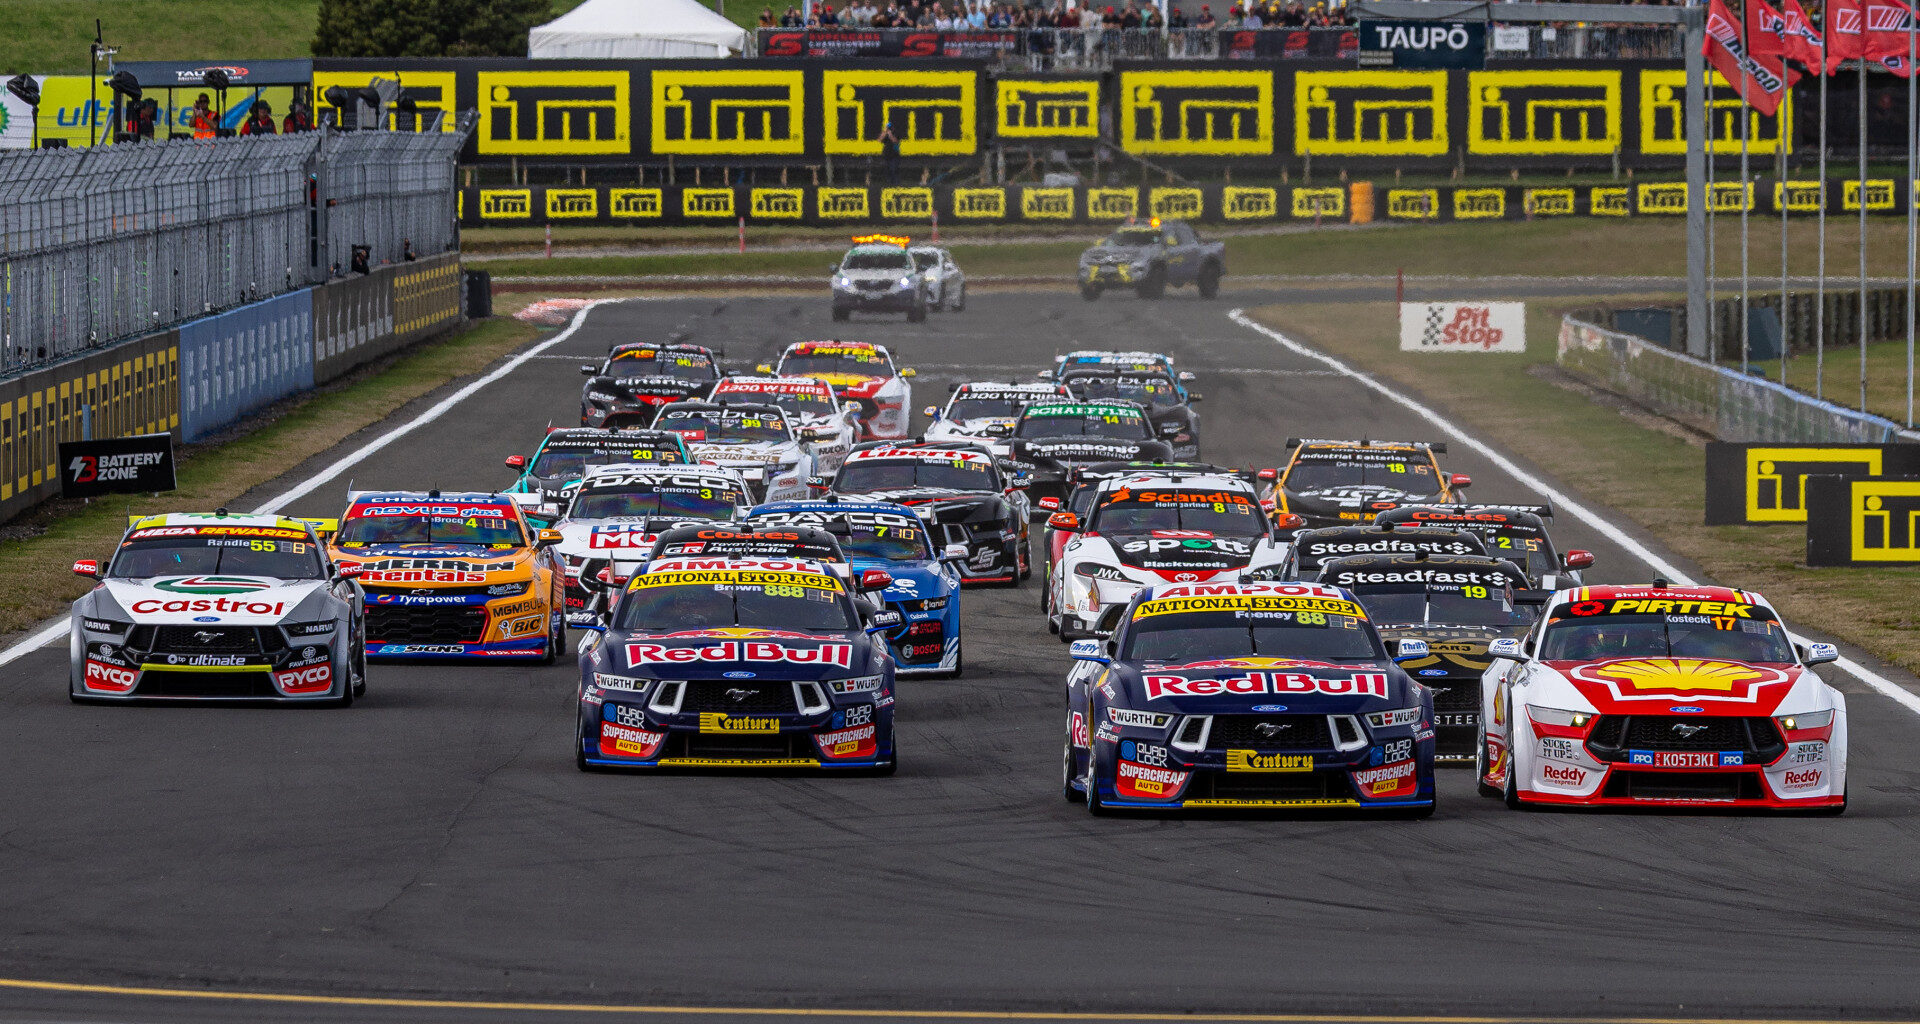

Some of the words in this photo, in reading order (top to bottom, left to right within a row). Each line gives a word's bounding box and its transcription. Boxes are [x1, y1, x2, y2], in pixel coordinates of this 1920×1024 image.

[1375, 24, 1469, 49] TAUPŌ
[1455, 307, 1489, 329] Pit
[1442, 324, 1503, 350] Stop
[1028, 406, 1141, 419] SCHAEFFLER
[743, 418, 761, 429] 99
[1103, 416, 1120, 425] 14
[633, 448, 653, 459] 20
[858, 448, 979, 462] Liberty
[1025, 442, 1141, 454] Panasonic
[98, 451, 163, 469] BATTERY
[1300, 452, 1352, 462] Industrial
[97, 466, 138, 481] ZONE
[1387, 462, 1406, 475] 18
[593, 473, 730, 490] DAYCO
[653, 486, 699, 496] Cameron
[701, 487, 713, 499] 3
[1139, 490, 1249, 506] Scandia
[371, 496, 497, 504] CHEVROLET
[460, 507, 504, 518] glass
[800, 503, 865, 513] Etheridge
[870, 505, 902, 514] Ford
[1213, 501, 1225, 514] 8
[466, 517, 478, 529] 4
[748, 511, 909, 526] DAYCO
[1412, 511, 1508, 523] Coates
[132, 527, 197, 539] MEGA
[198, 526, 308, 540] REWARDS
[874, 526, 889, 538] 7
[208, 538, 250, 548] Randle
[251, 540, 277, 552] 55
[666, 543, 703, 556] GR
[708, 544, 788, 555] Australia
[1310, 538, 1442, 556] Steadfast
[1498, 536, 1512, 549] 2
[653, 558, 826, 573] AMPOL
[1143, 560, 1229, 569] Blackwoods
[357, 569, 487, 583] Rentals
[637, 571, 735, 589] NATIONAL
[741, 573, 836, 590] STORAGE
[1337, 570, 1481, 585] Steadfast
[713, 583, 762, 593] Brown
[765, 585, 804, 599] 888
[1158, 584, 1339, 598] AMPOL
[1461, 585, 1488, 599] 19
[1614, 591, 1648, 599] Shell
[132, 597, 285, 616] Castrol
[399, 594, 467, 606] Tyrepower
[1140, 599, 1246, 615] NATIONAL
[1254, 598, 1355, 614] STORAGE
[1609, 600, 1753, 618] PIRTEK
[1296, 611, 1326, 625] 88
[1665, 614, 1711, 625] Kostecki
[1711, 616, 1736, 630] 17
[625, 641, 739, 669] Red
[744, 641, 852, 669] Bull
[913, 643, 941, 656] BOSCH
[189, 654, 247, 667] ultimate
[87, 663, 136, 687] RYCO
[278, 664, 331, 689] RYCO
[599, 677, 633, 690] WÜRTH
[1142, 672, 1269, 701] Red
[1272, 672, 1389, 701] Bull
[616, 705, 645, 721] QUAD
[845, 704, 872, 719] QUAD
[1116, 711, 1153, 725] WÜRTH
[616, 715, 646, 730] LOCK
[714, 714, 780, 732] Century
[844, 714, 872, 728] LOCK
[602, 723, 663, 746] SUPERCHEAP
[818, 725, 876, 748] SUPERCHEAP
[618, 741, 640, 751] AUTO
[836, 744, 857, 754] AUTO
[1384, 739, 1412, 755] QUAD
[1542, 738, 1566, 750] SUCK
[1797, 743, 1818, 754] SUCK
[1136, 743, 1168, 760] QUAD
[1383, 750, 1411, 764] LOCK
[1543, 748, 1552, 758] IT
[1554, 749, 1566, 759] UP
[1796, 753, 1805, 763] IT
[1806, 752, 1818, 762] UP
[1136, 752, 1168, 768] LOCK
[1242, 752, 1314, 771] Century
[1633, 754, 1653, 764] PPQ
[1723, 756, 1742, 765] PPQ
[1118, 763, 1187, 786] SUPERCHEAP
[1355, 765, 1416, 786] SUPERCHEAP
[1543, 764, 1587, 786] Reddy
[1784, 769, 1822, 787] Reddy
[1137, 782, 1161, 792] AUTO
[1375, 782, 1397, 793] AUTO
